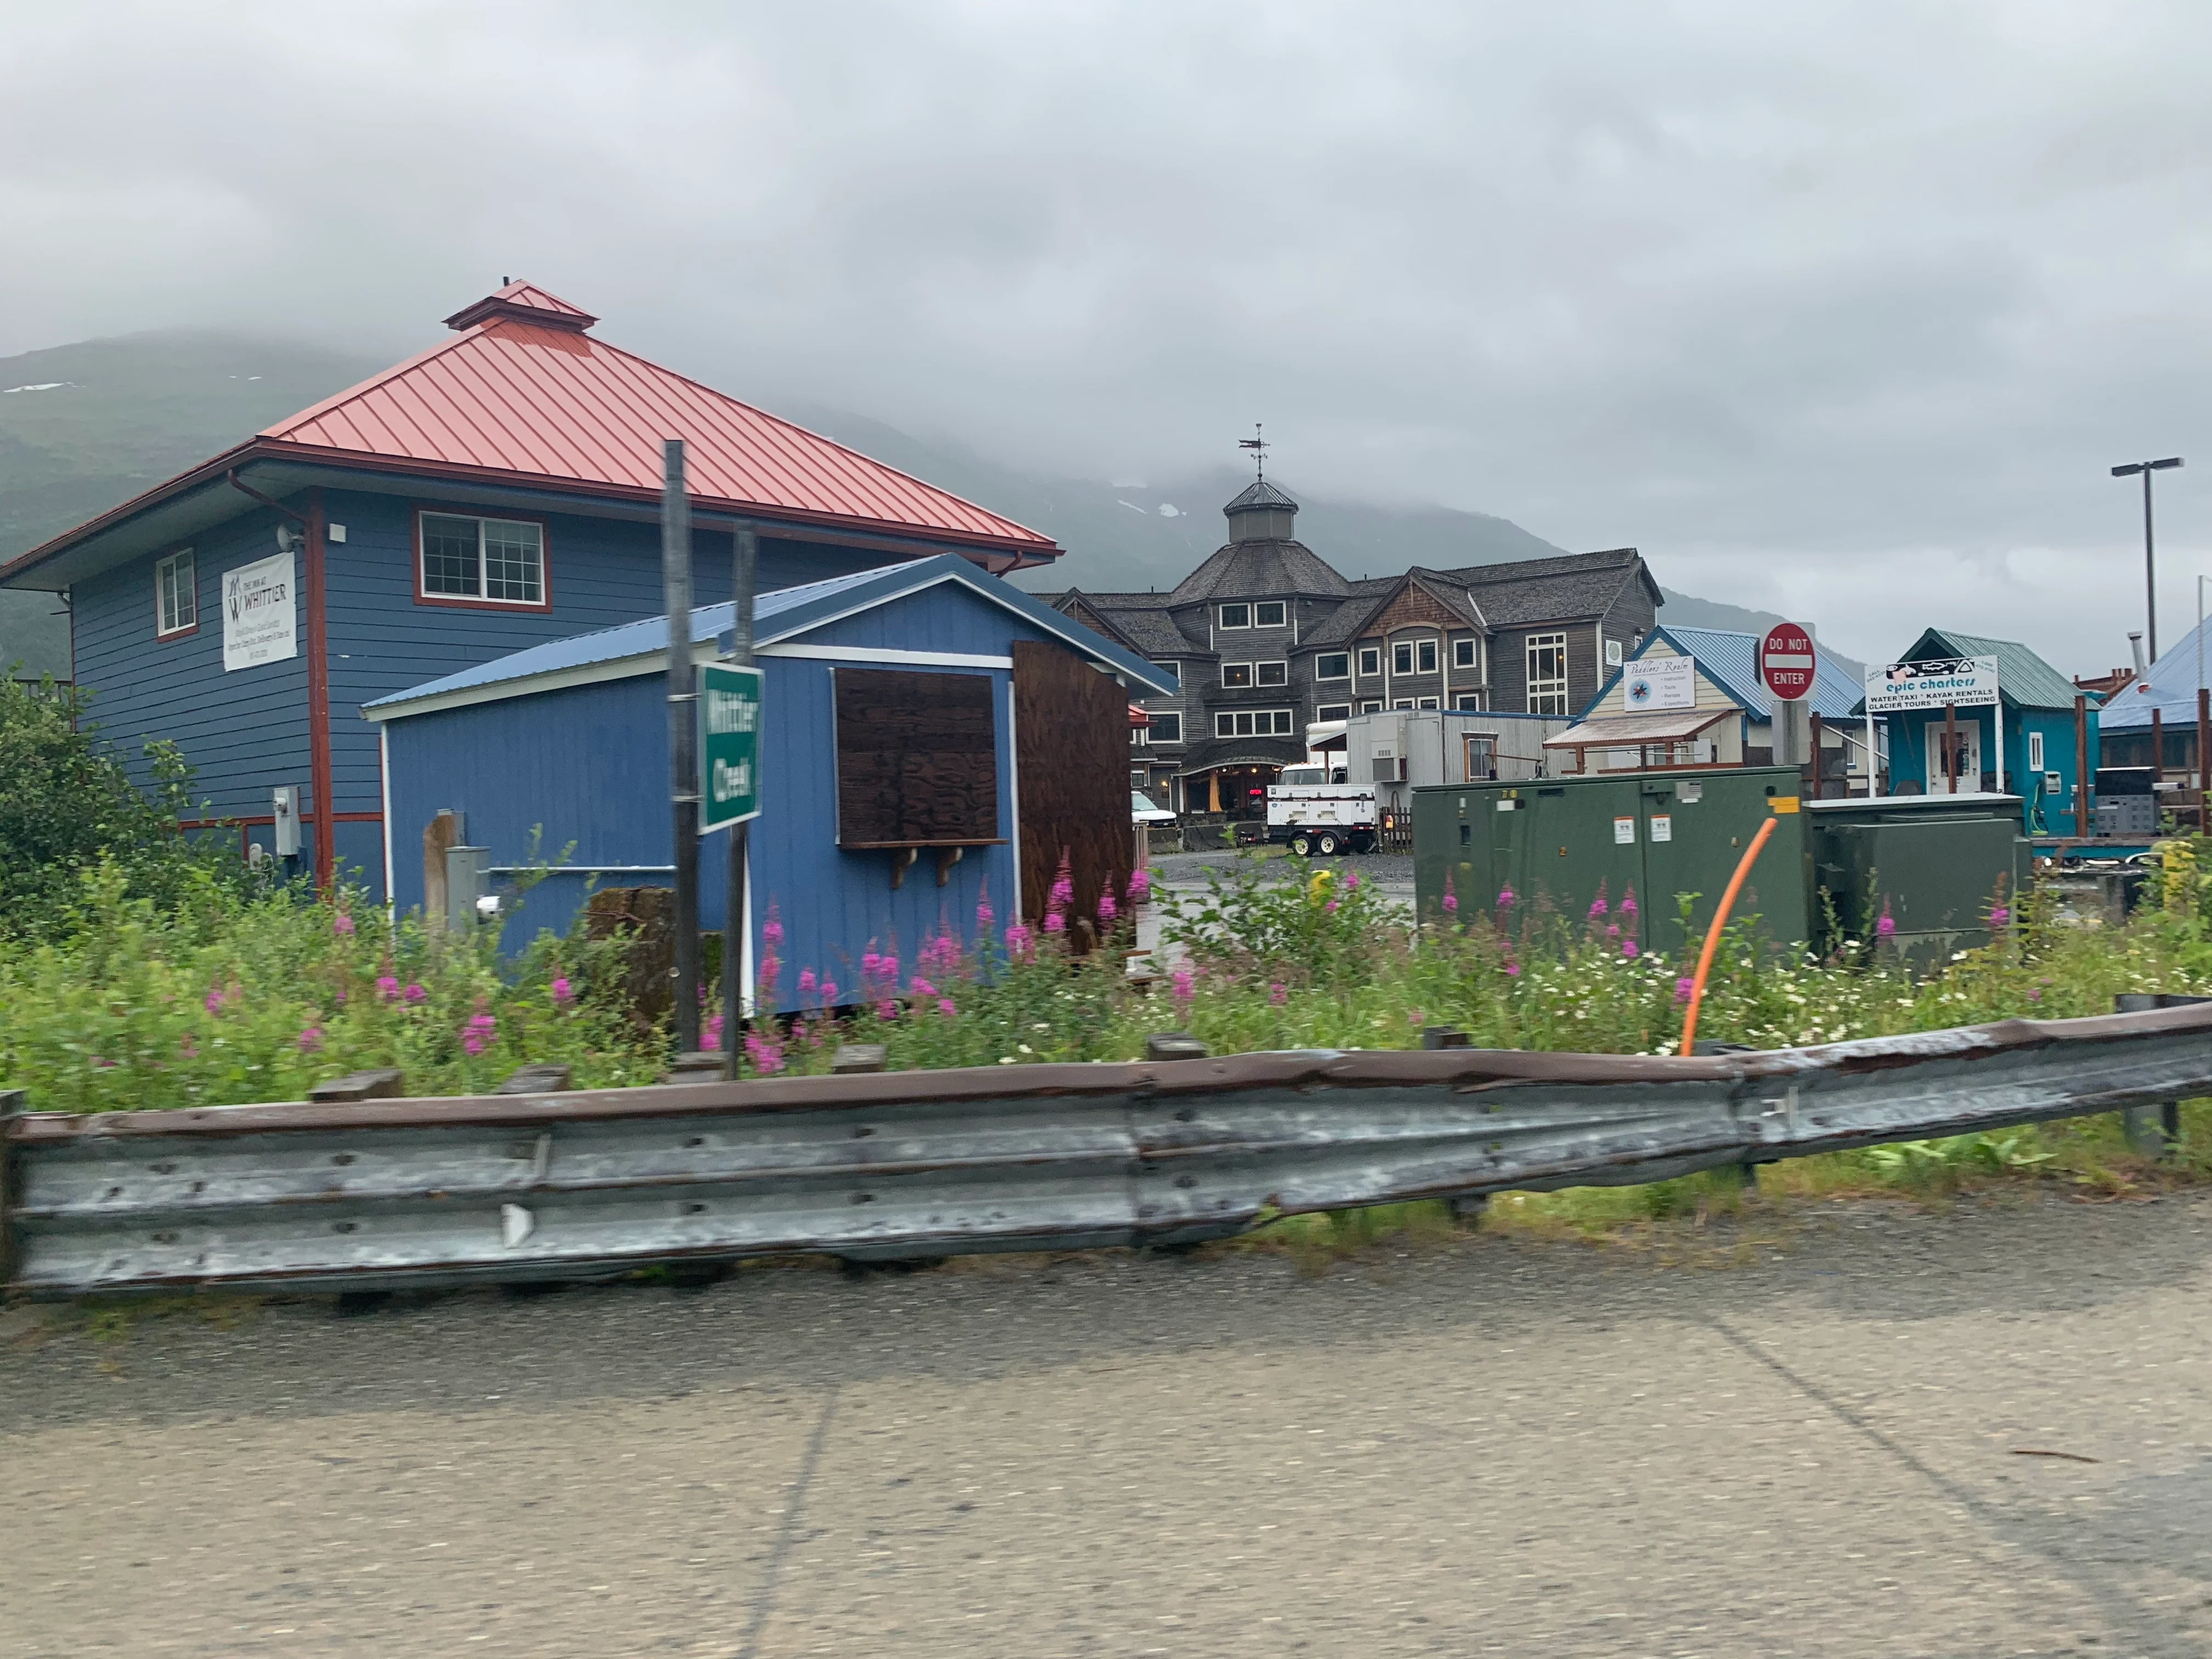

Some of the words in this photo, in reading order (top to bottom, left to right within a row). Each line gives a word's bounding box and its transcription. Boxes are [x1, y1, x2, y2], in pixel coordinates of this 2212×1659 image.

[244, 583, 286, 611] WHITTIER
[1769, 638, 1783, 650] DO
[1788, 639, 1808, 651] NOT
[1666, 658, 1688, 672] Realm
[1773, 672, 1805, 685] ENTER
[1887, 680, 1915, 693] epic
[1920, 677, 1975, 689] charters
[1939, 696, 1996, 706] SIGHTSEEING
